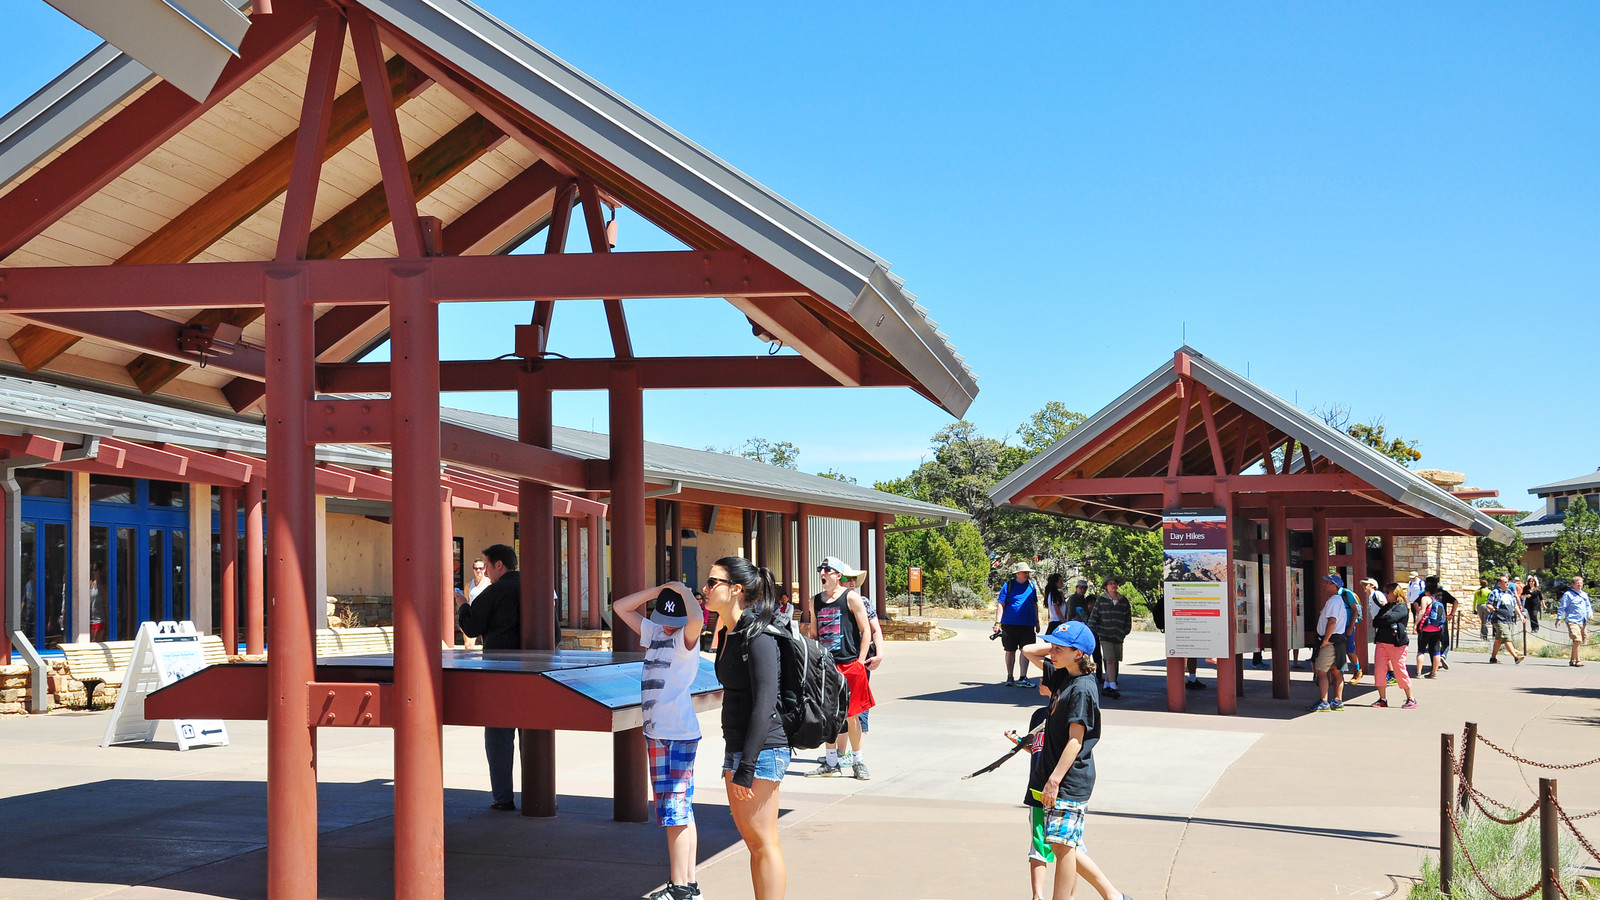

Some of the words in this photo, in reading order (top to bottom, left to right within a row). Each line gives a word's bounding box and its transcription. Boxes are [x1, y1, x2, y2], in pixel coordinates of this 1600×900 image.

[1170, 533, 1184, 542] Day
[1186, 532, 1205, 540] Hikes
[664, 600, 676, 613] NY
